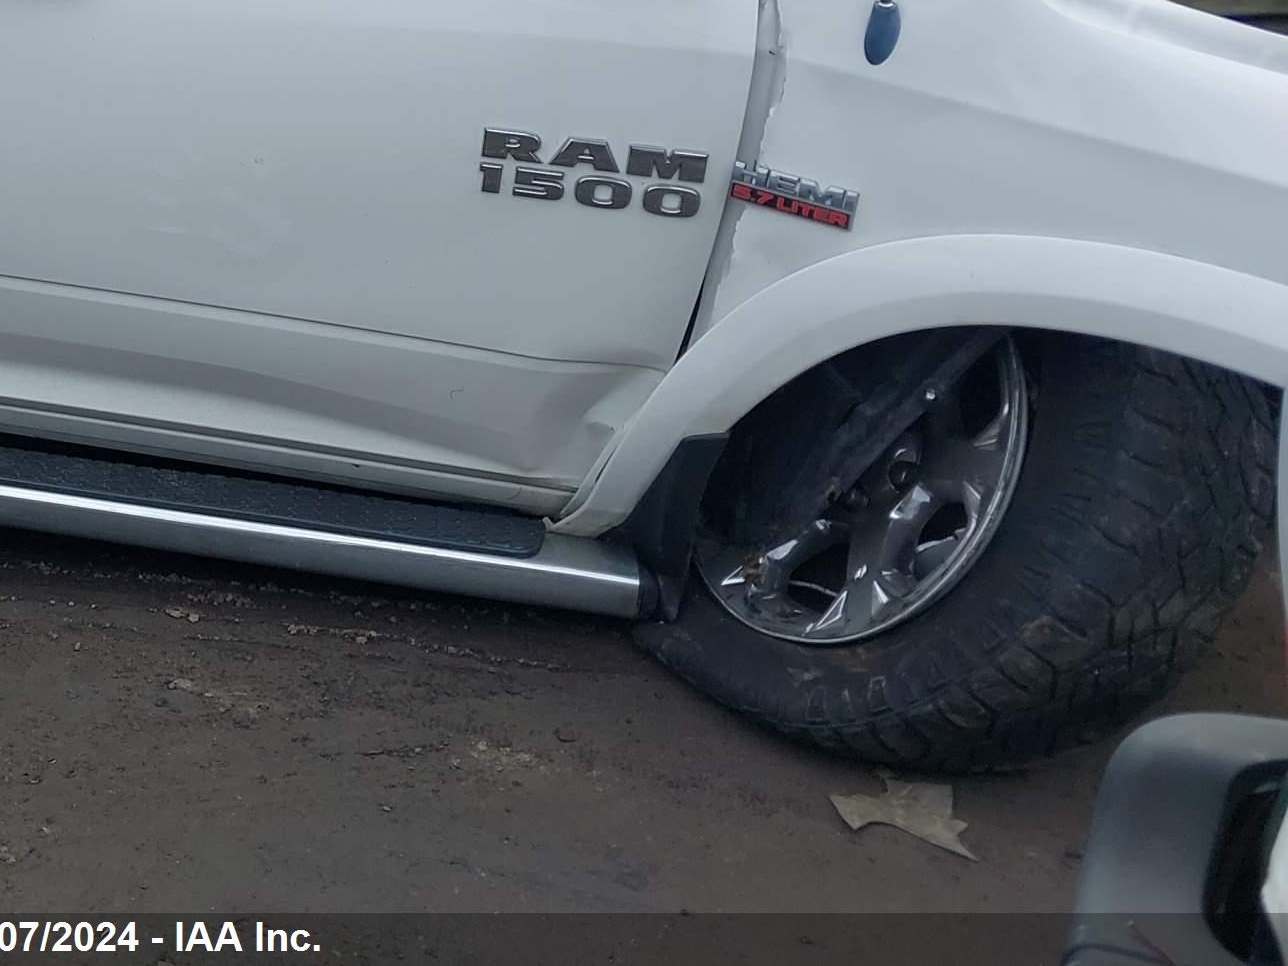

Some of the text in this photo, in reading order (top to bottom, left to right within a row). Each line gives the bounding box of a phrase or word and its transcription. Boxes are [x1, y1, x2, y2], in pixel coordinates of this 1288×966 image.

[482, 127, 709, 183] RAM
[479, 162, 701, 218] 1500
[732, 161, 860, 214] HEMI
[732, 184, 849, 226] 5.7 LITER
